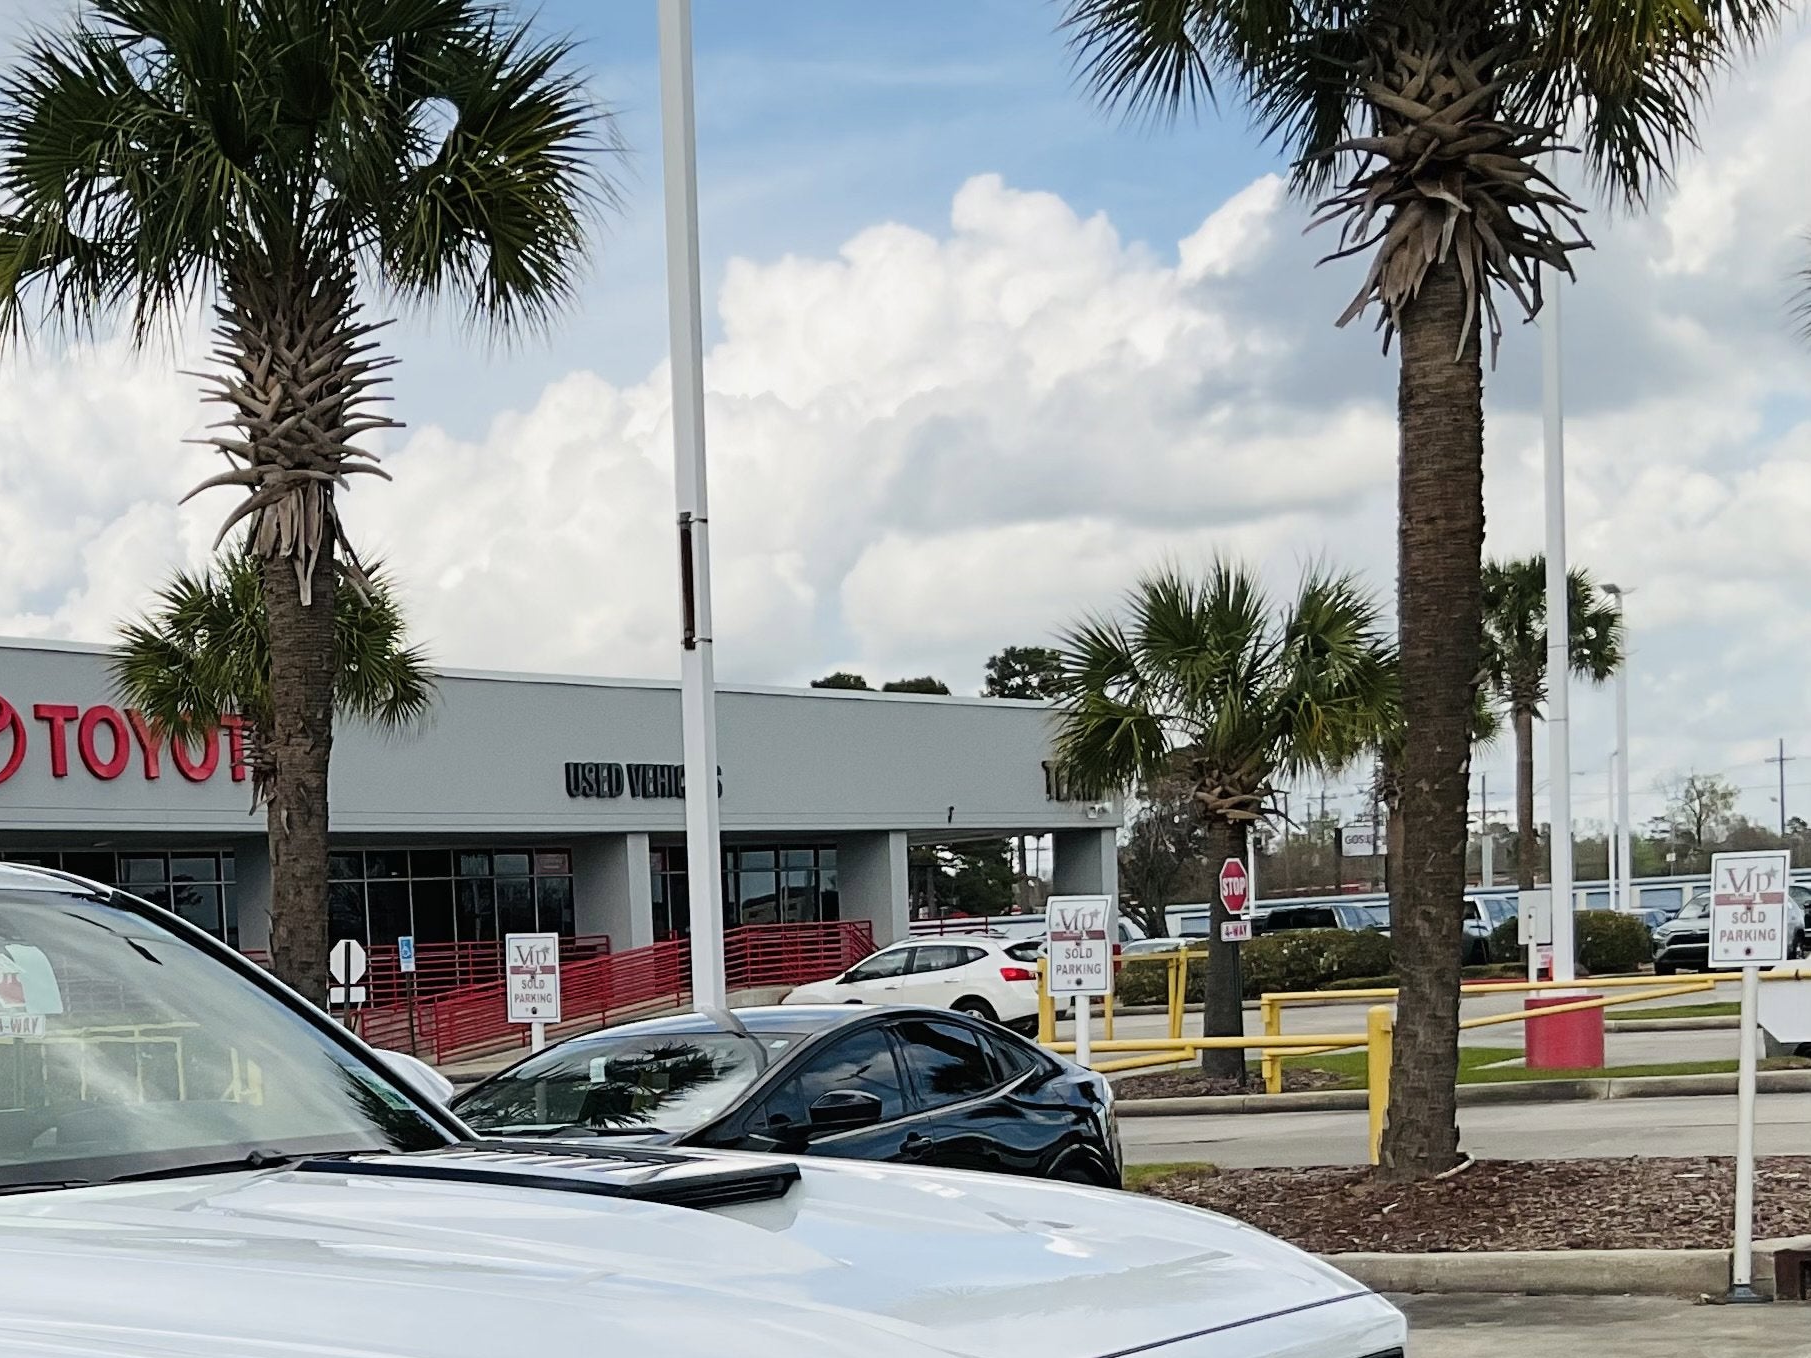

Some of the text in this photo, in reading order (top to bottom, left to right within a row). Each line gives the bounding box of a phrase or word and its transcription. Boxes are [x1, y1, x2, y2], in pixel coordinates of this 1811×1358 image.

[33, 703, 255, 783] TOYOT
[564, 762, 723, 799] USED VEHIC
[1222, 876, 1246, 897] STOP
[1731, 911, 1767, 924] SOLD
[1225, 924, 1248, 938] 4-WAY
[1719, 928, 1777, 943] PARKING
[1064, 947, 1093, 960] SOLD
[1056, 963, 1102, 976] PARKING
[521, 979, 545, 990] SOLD
[514, 993, 553, 1004] PARKING
